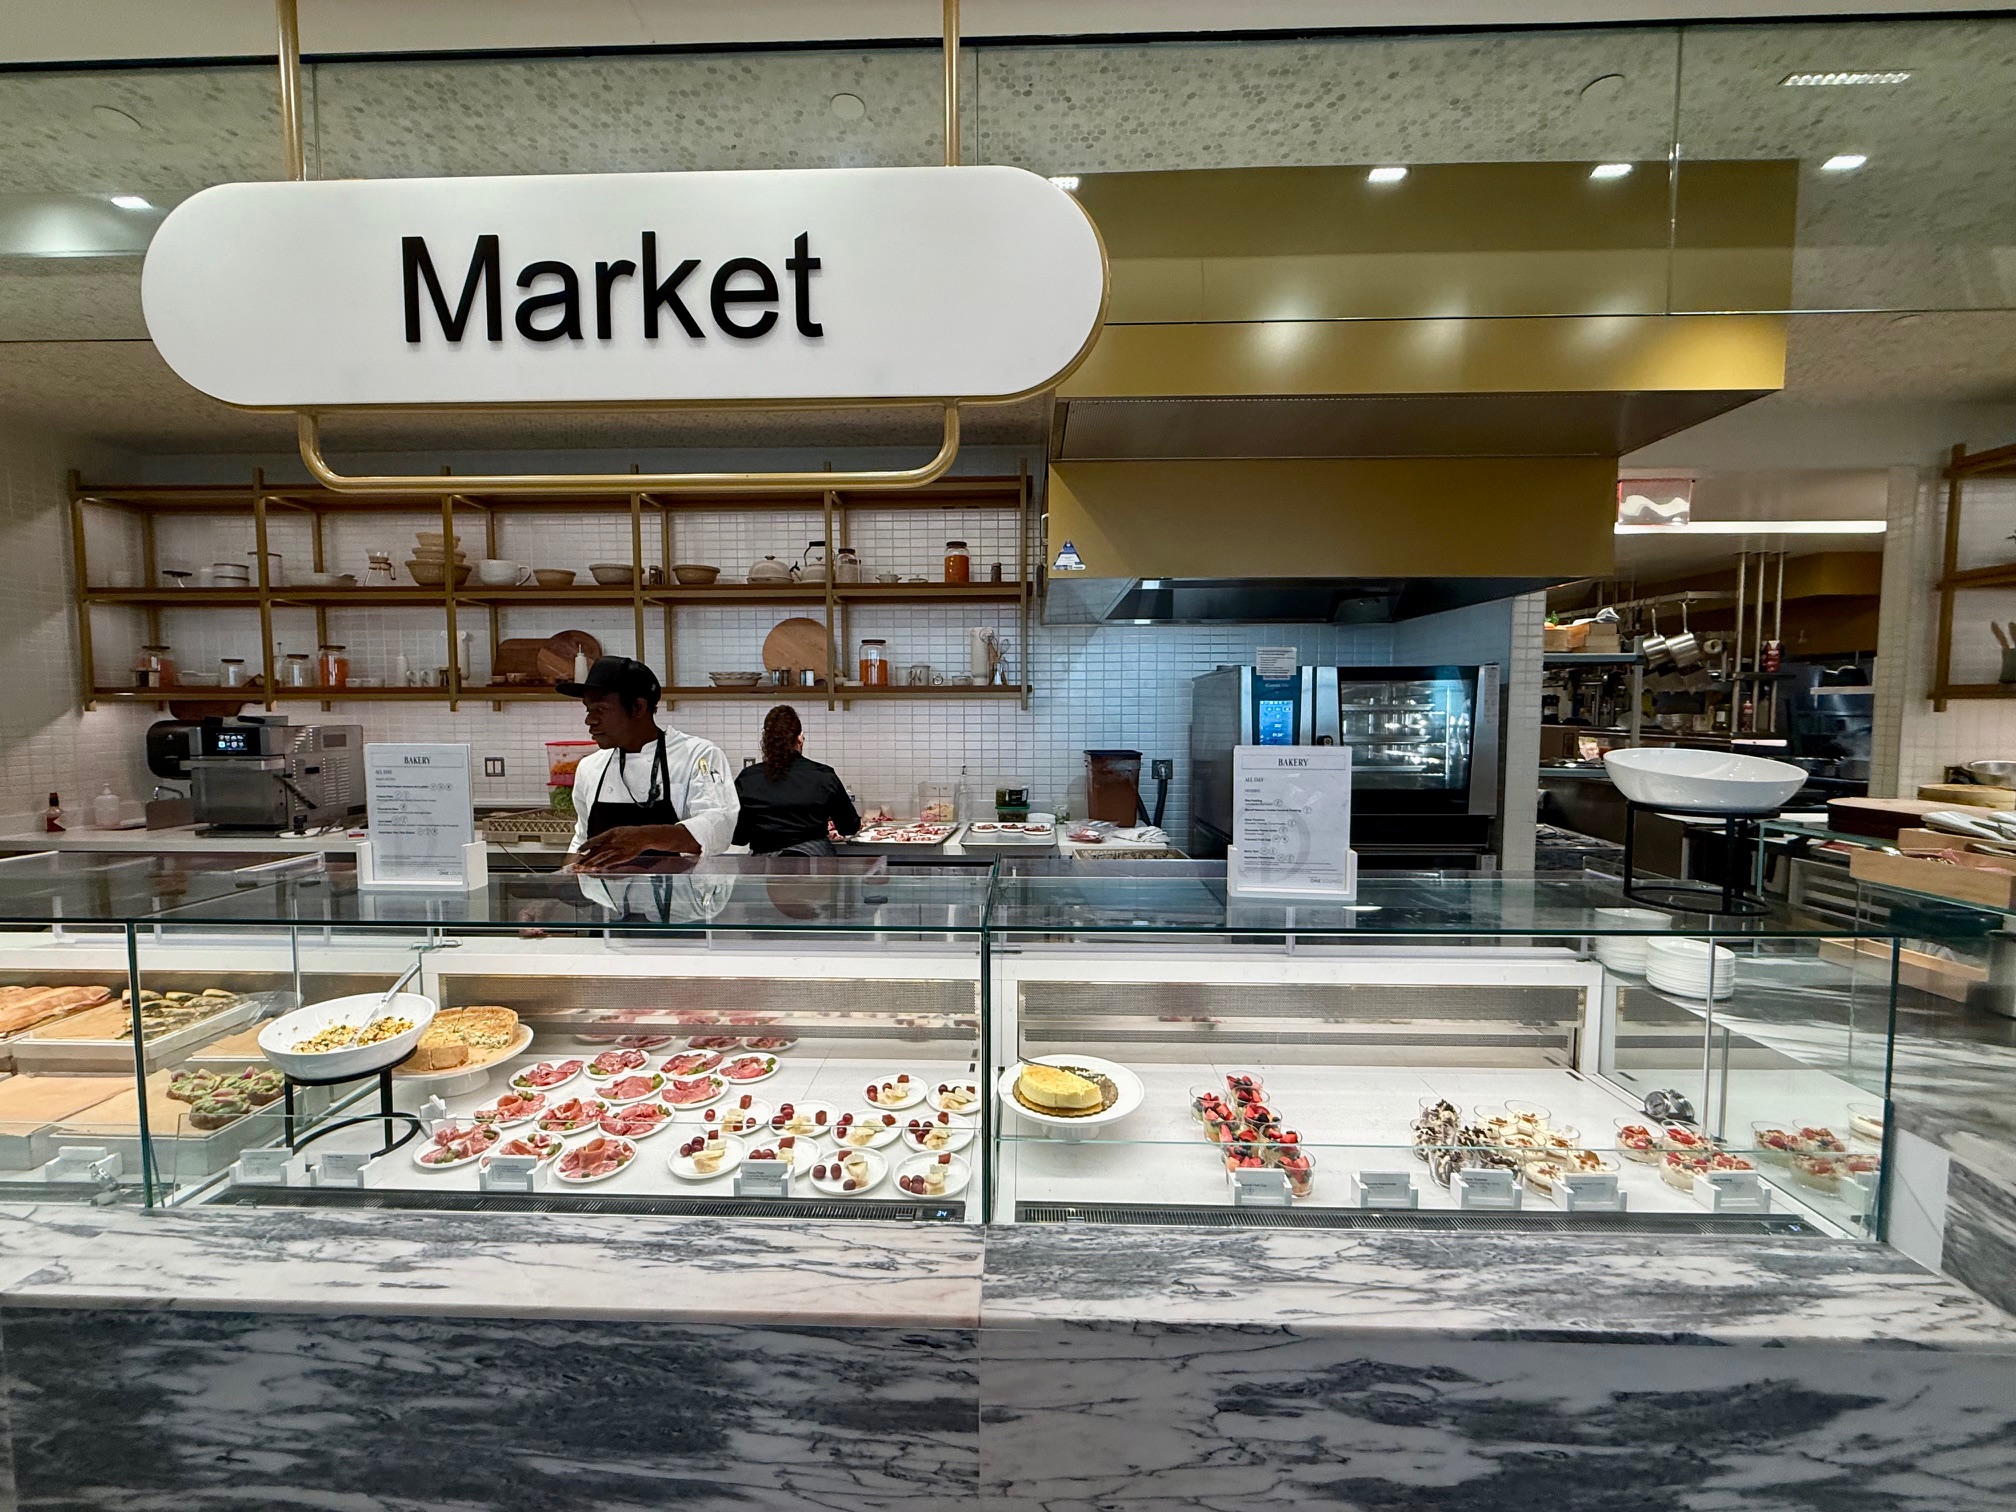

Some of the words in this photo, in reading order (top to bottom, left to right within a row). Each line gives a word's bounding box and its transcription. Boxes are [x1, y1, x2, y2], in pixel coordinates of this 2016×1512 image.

[402, 231, 824, 342] Market
[404, 756, 431, 764] BAKERY
[1278, 758, 1308, 766] BAKERY
